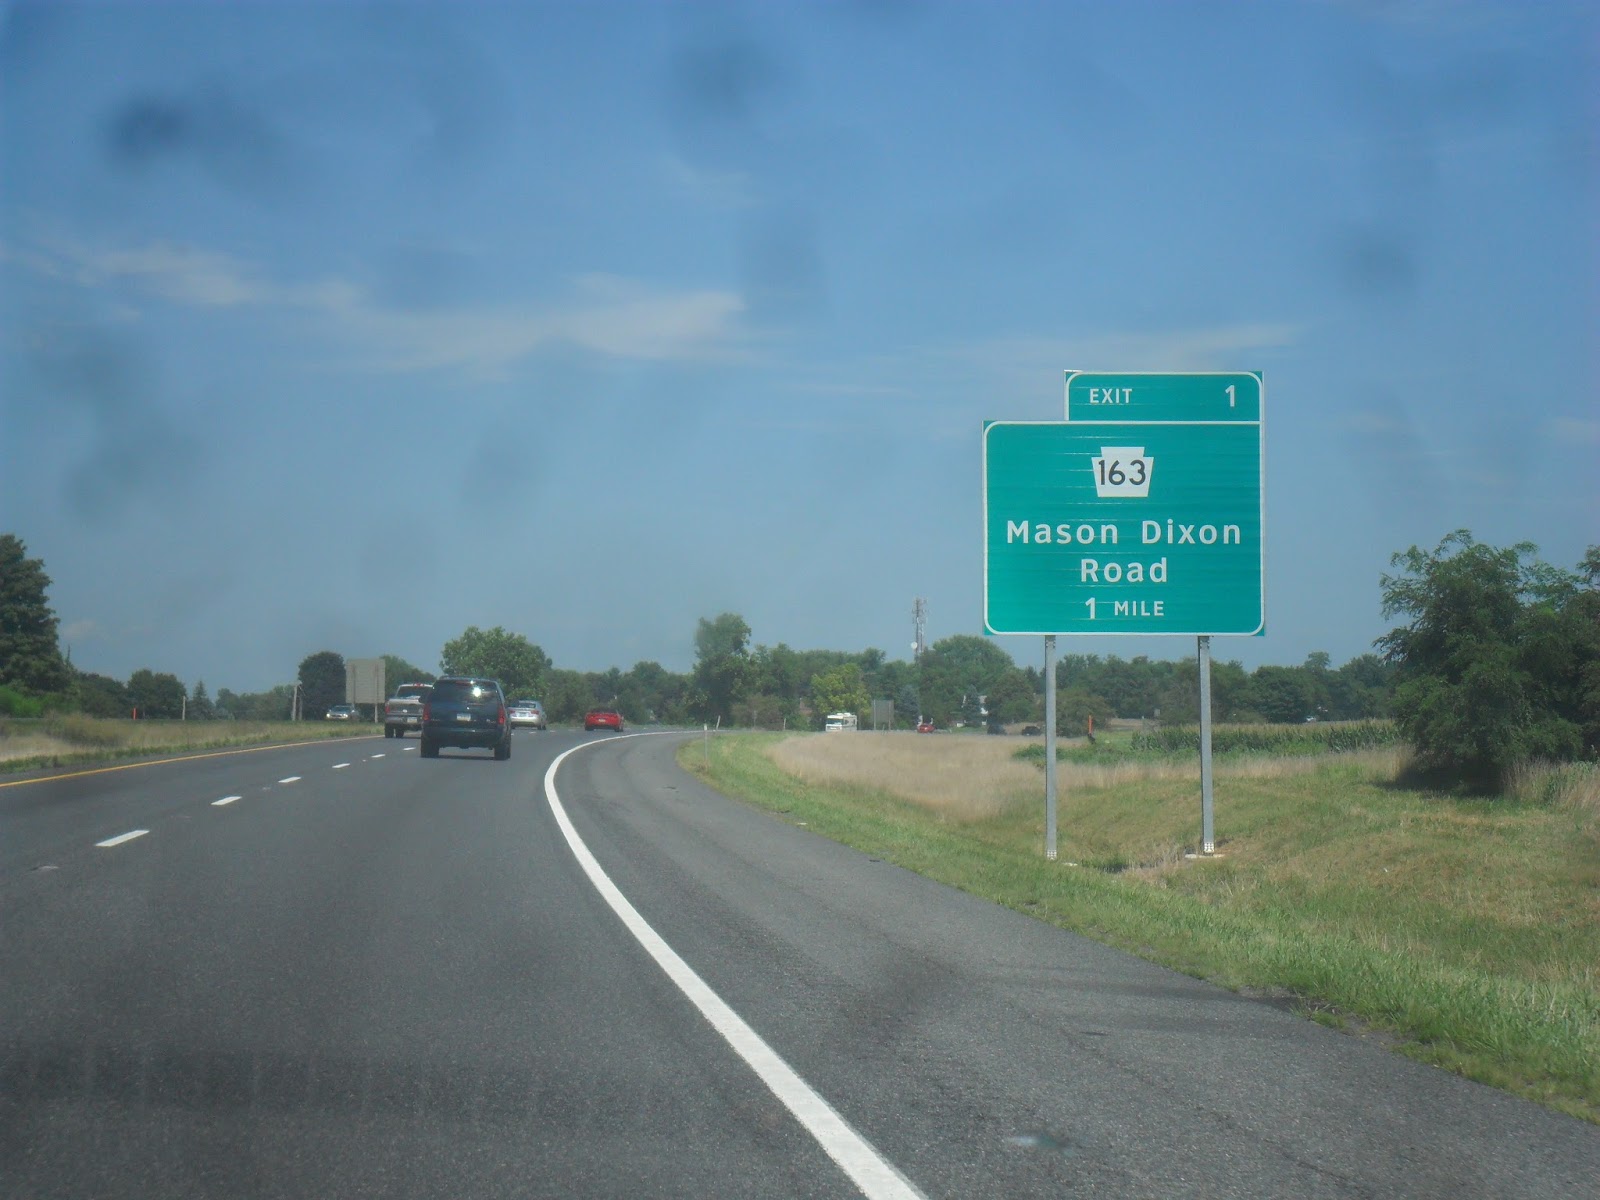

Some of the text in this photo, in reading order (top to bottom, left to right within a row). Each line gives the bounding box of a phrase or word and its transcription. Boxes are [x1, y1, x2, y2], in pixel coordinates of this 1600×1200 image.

[1089, 384, 1236, 407] EXIT 1
[1098, 459, 1146, 485] 163
[1006, 518, 1241, 544] Mason Dixon
[1080, 557, 1168, 582] Road
[1085, 597, 1165, 620] 1 MILE
